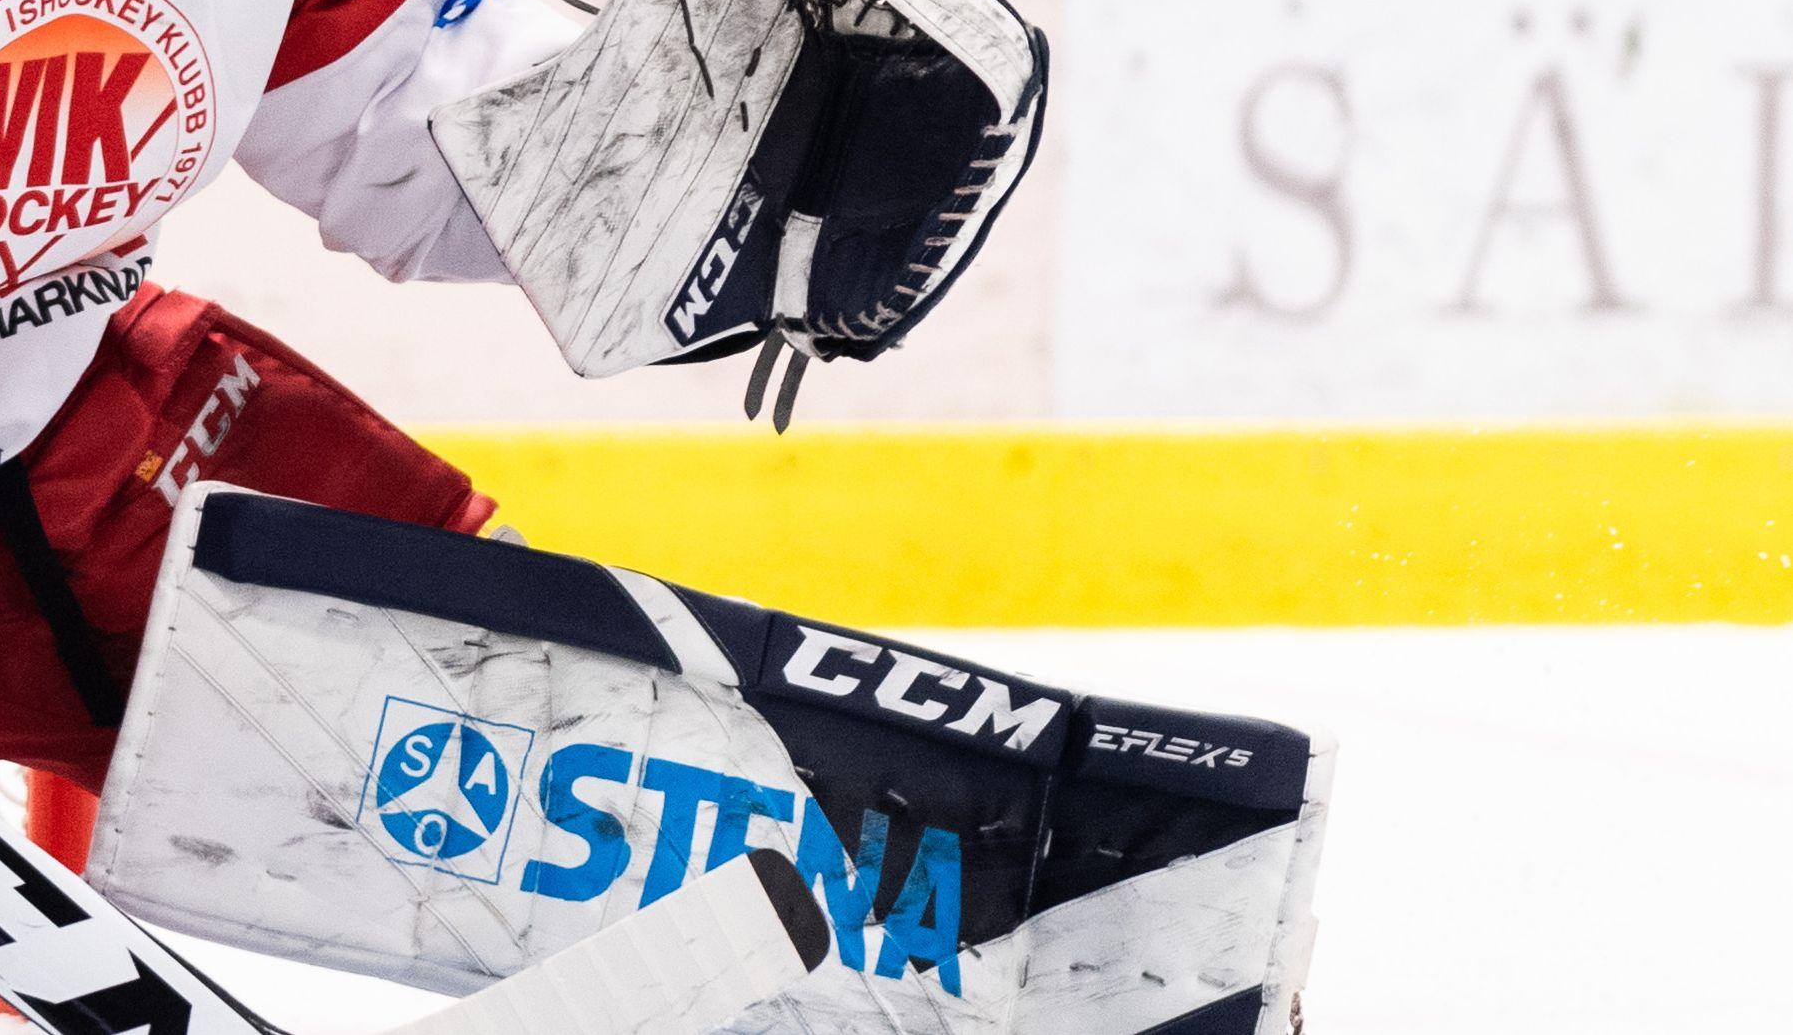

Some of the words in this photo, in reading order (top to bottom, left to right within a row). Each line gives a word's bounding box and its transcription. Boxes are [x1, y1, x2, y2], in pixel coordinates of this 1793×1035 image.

[154, 142, 203, 203] 1971
[672, 182, 765, 340] CCM
[152, 354, 261, 509] CCM
[781, 625, 1062, 752] CCM
